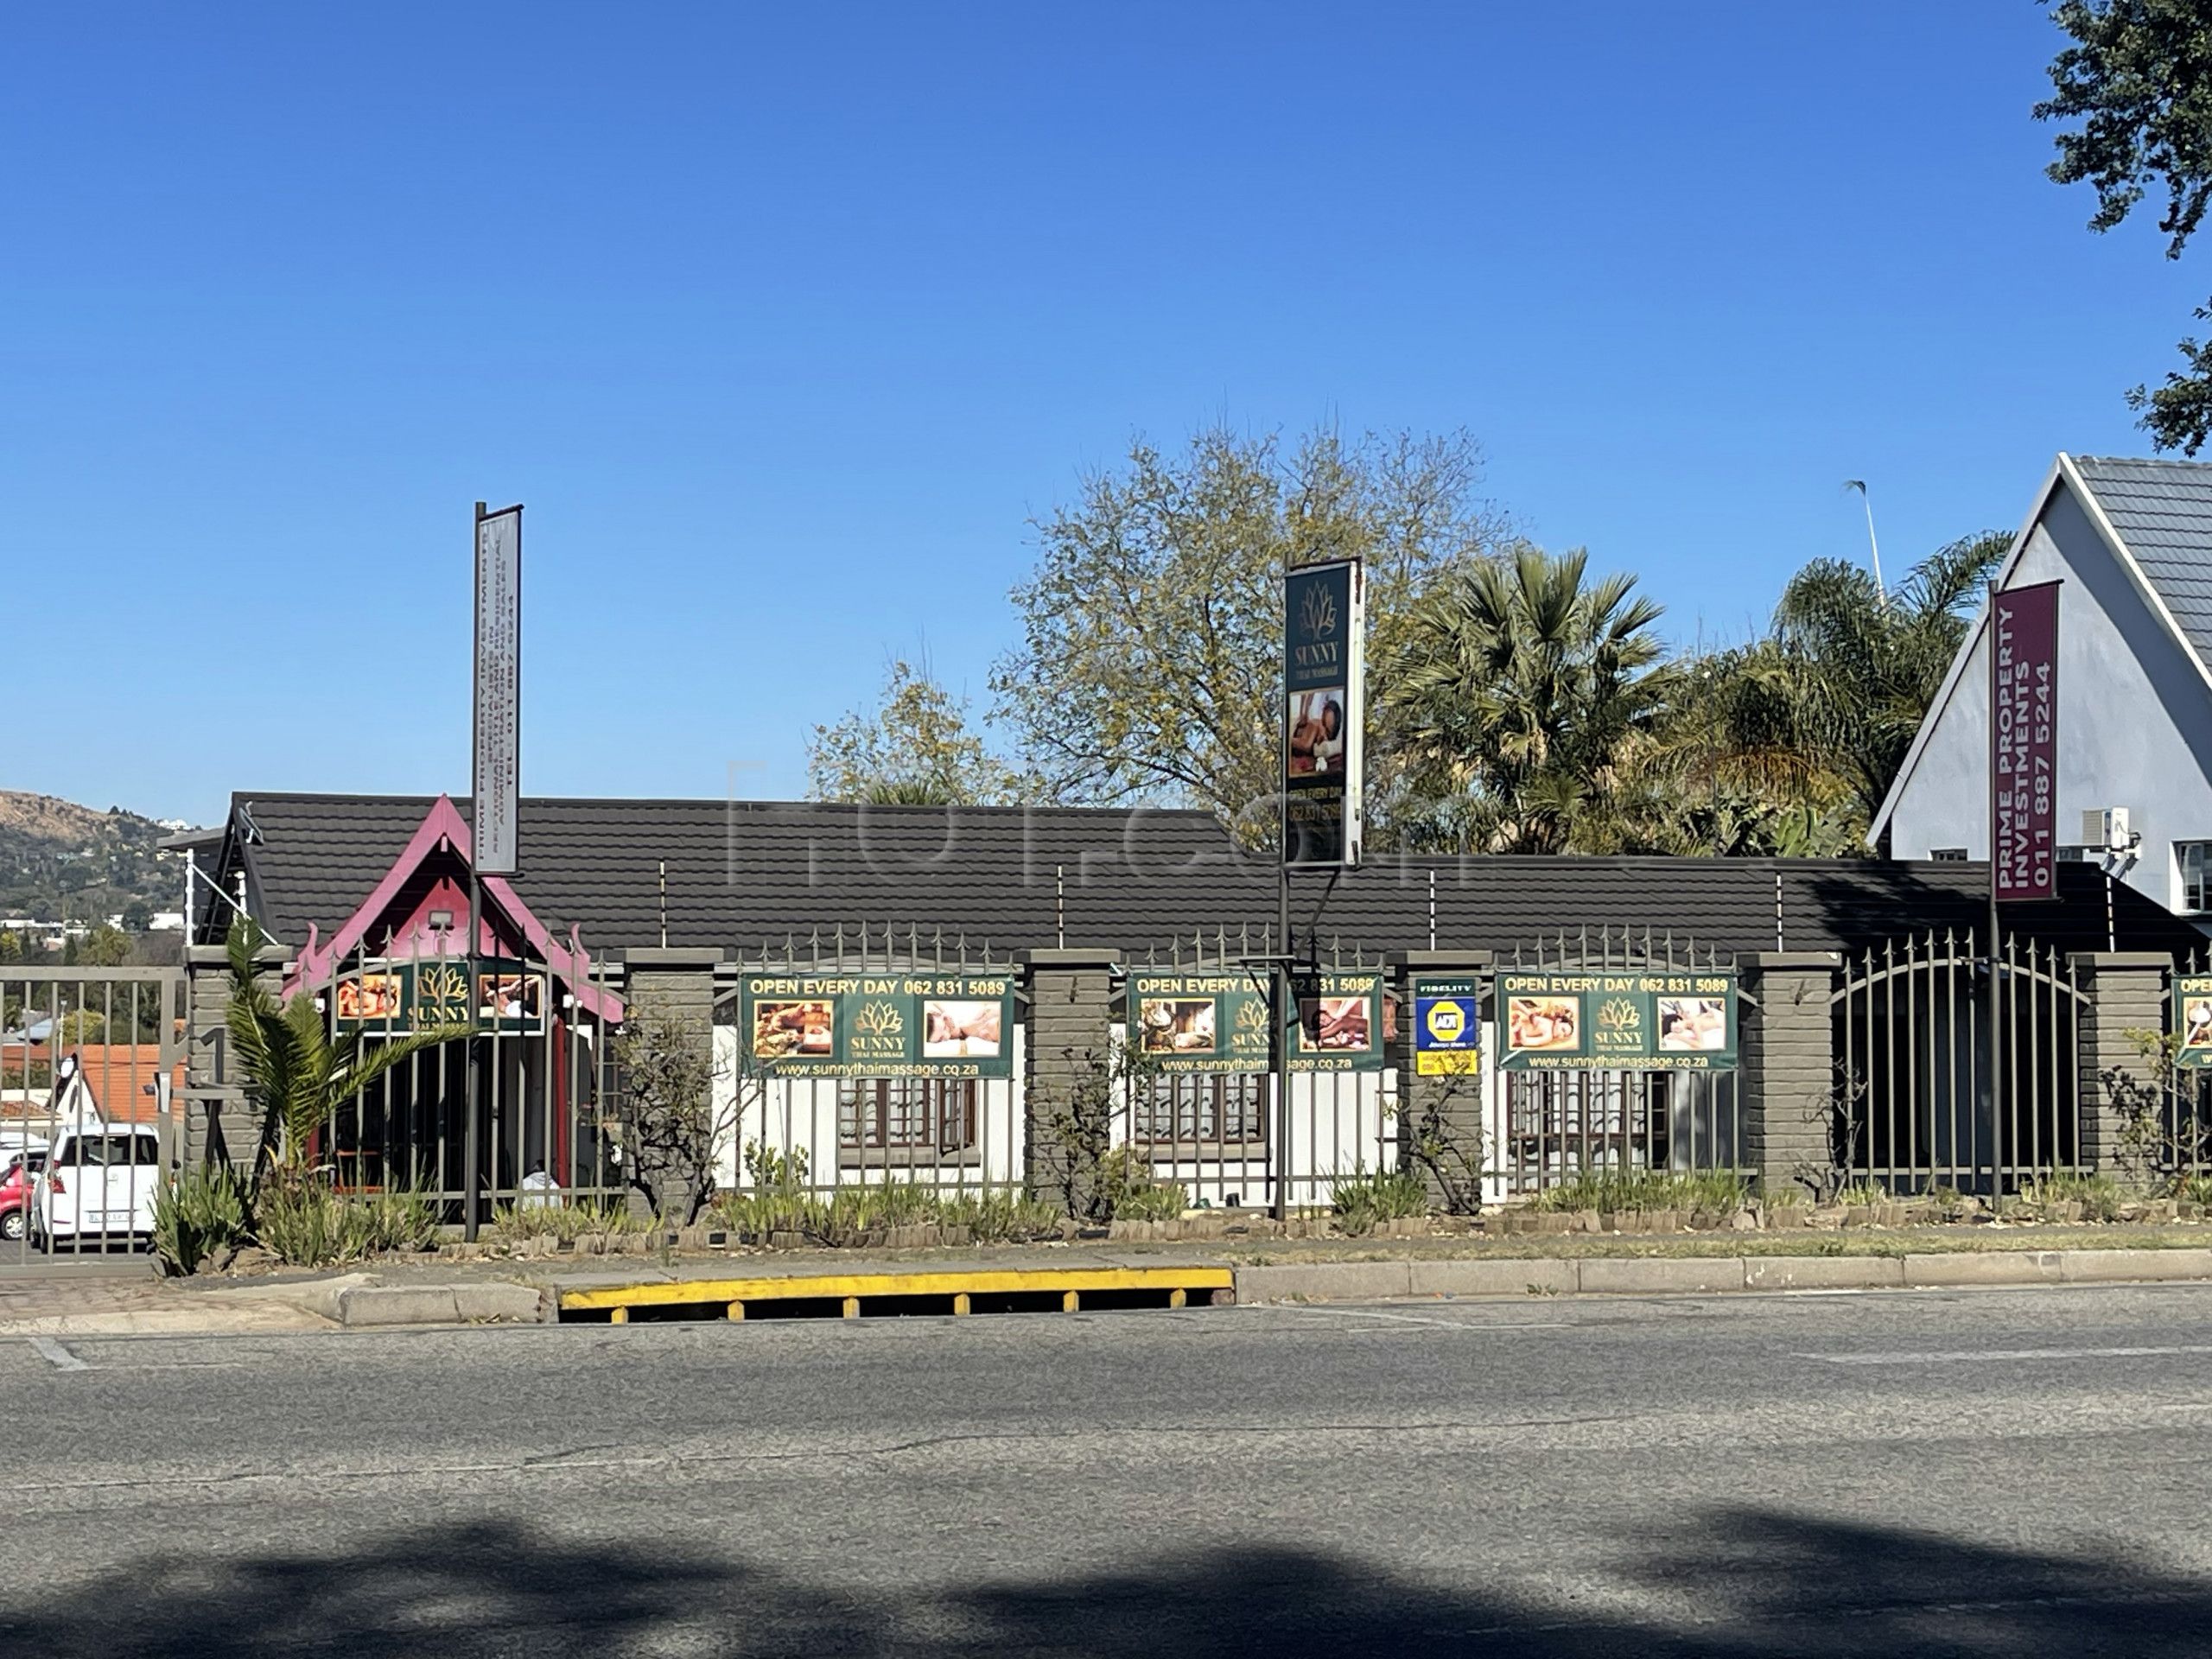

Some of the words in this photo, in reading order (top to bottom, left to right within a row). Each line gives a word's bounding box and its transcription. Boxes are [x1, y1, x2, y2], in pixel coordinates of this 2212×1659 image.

[1294, 642, 1338, 666] SUNNY
[1999, 607, 2013, 774] PROPERTY
[2034, 662, 2050, 743] 5244
[2015, 660, 2030, 888] INVESTMENTS
[2034, 760, 2050, 816] 887
[1999, 790, 2012, 889] PRIME
[2034, 830, 2050, 887] 011
[750, 980, 798, 994] OPEN
[804, 980, 860, 994] EVERY
[865, 980, 898, 994] DAY
[904, 980, 931, 995] 062
[937, 981, 963, 995] 831
[969, 981, 1006, 995] 5089
[1137, 978, 1182, 993] OPEN
[1186, 978, 1239, 992] EVERY
[1505, 978, 1548, 992] OPEN
[1552, 978, 1600, 992] EVERY
[1605, 978, 1634, 992] DAY
[1639, 978, 1664, 992] 062
[1669, 978, 1692, 992] 831
[1696, 978, 1728, 992] 5089
[1436, 1014, 1458, 1028] ADT
[850, 1037, 906, 1050] SUNNY
[1594, 1032, 1643, 1044] SUNNY
